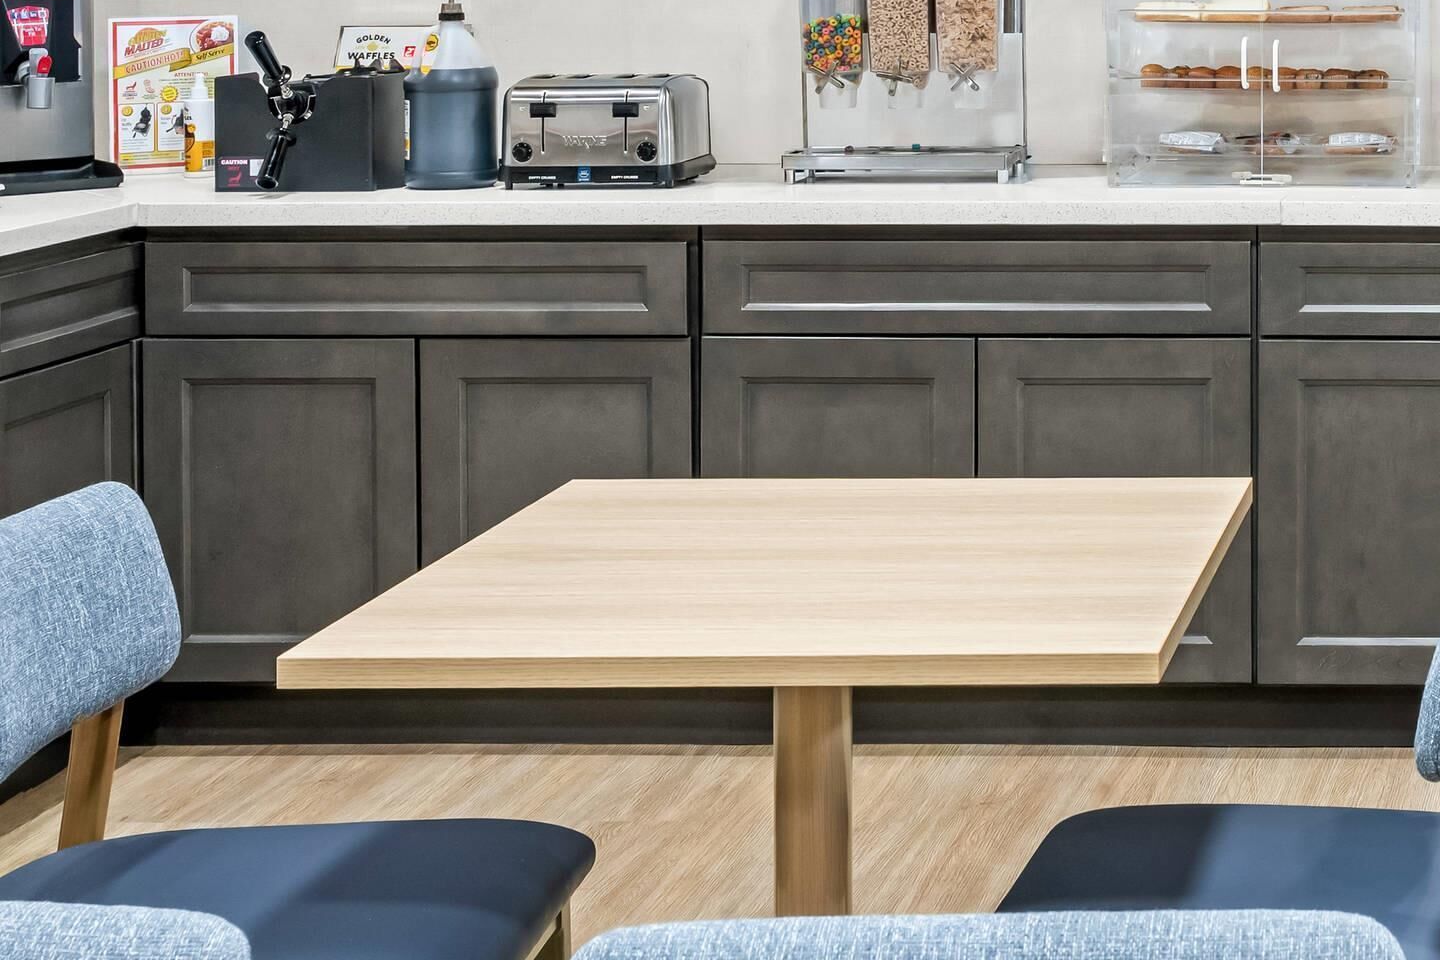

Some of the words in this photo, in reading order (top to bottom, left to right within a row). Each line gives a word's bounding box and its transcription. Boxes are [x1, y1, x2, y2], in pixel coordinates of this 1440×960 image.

[356, 34, 391, 44] GOLDEN
[124, 38, 164, 57] MALTED
[125, 57, 162, 74] CAUTION
[163, 51, 184, 64] HOT!
[196, 50, 207, 61] Self
[208, 48, 226, 58] Serve
[348, 52, 395, 60] WAFFLES
